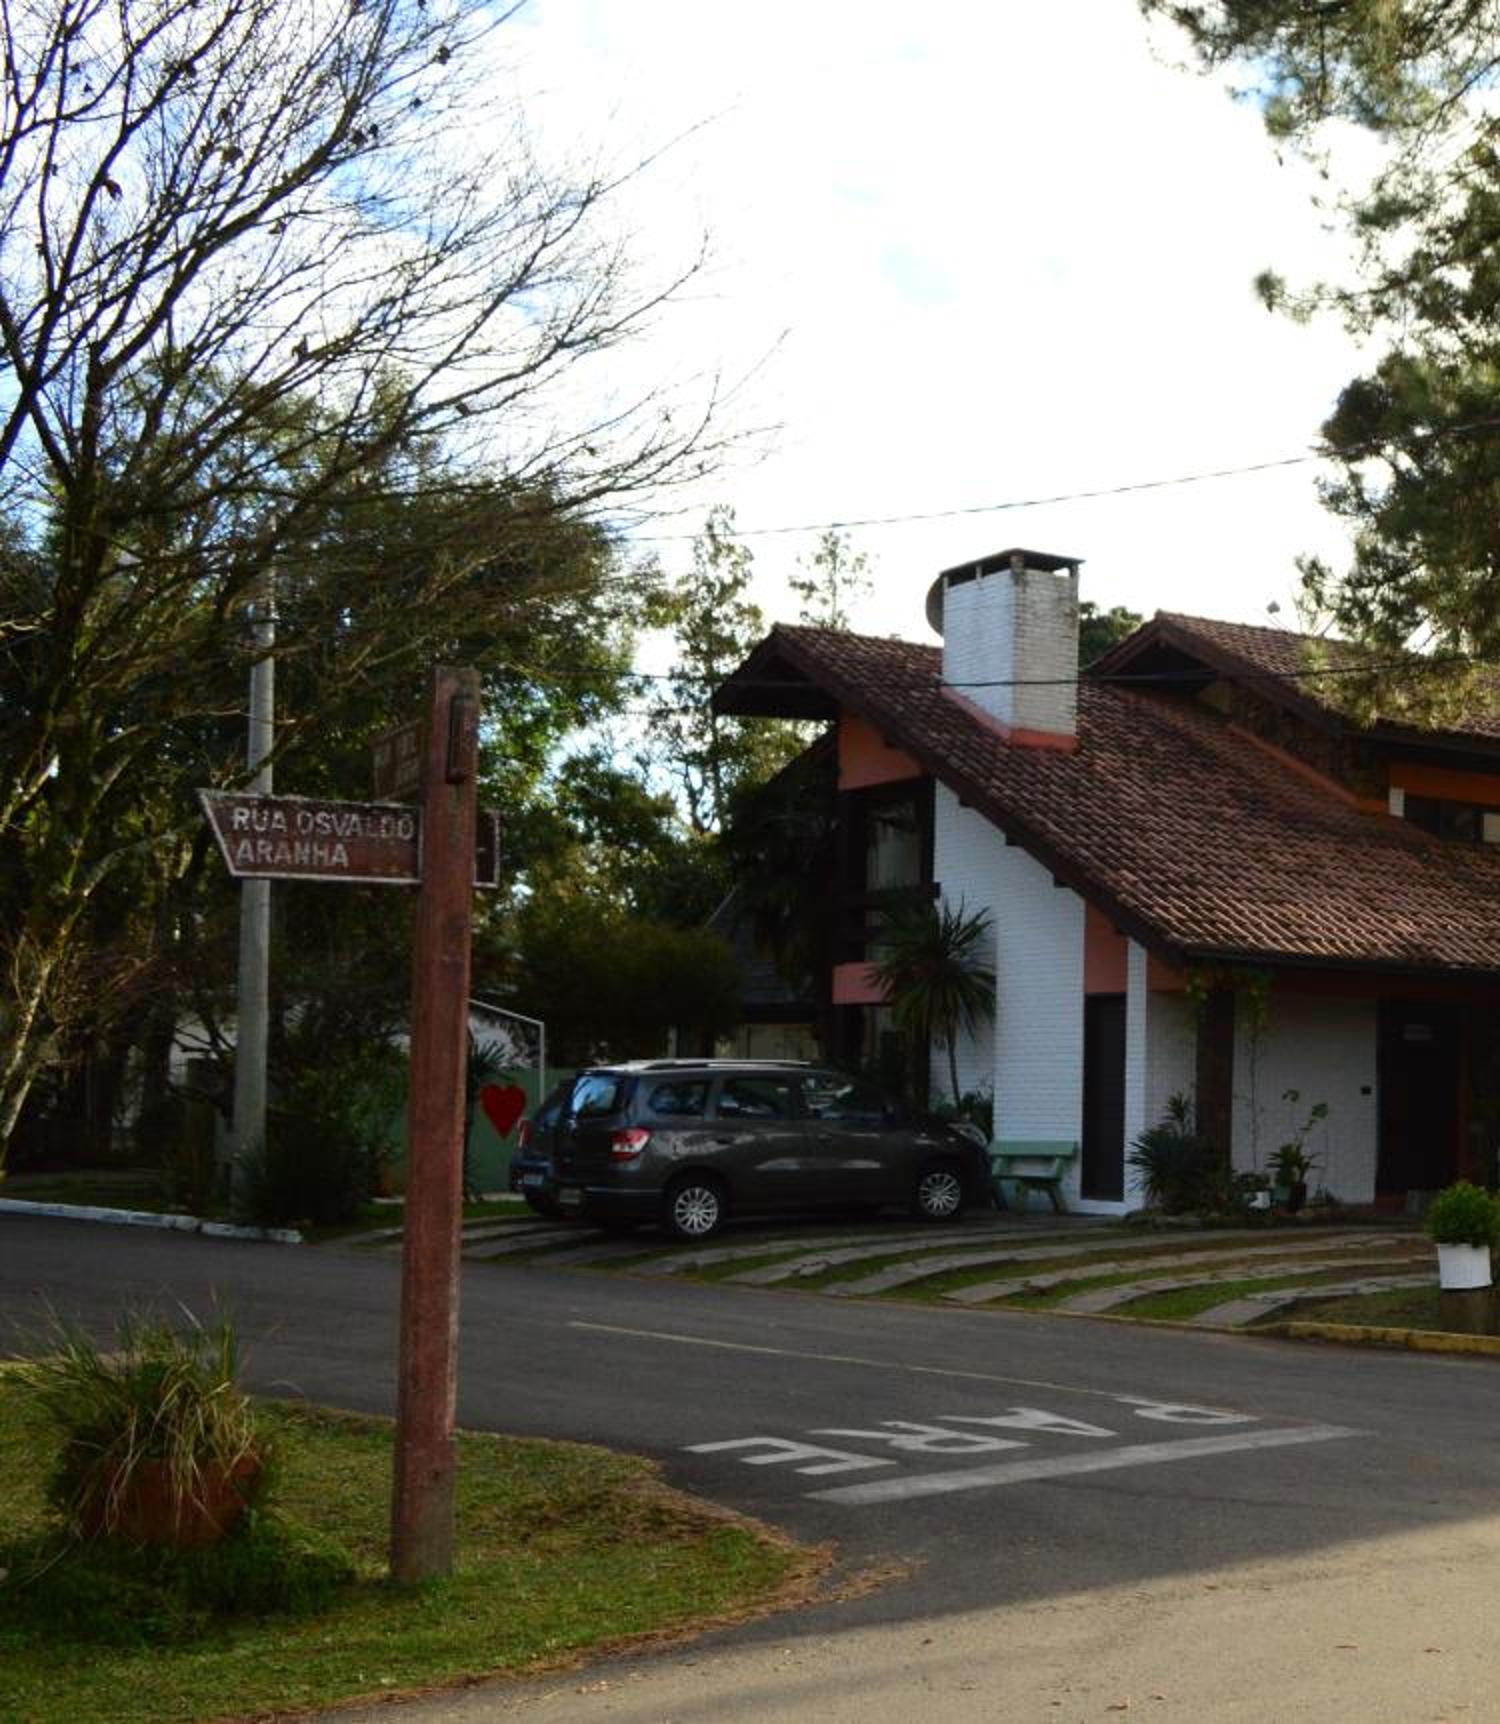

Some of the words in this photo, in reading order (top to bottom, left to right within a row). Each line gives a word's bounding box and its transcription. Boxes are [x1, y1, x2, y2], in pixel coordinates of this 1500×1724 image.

[233, 807, 288, 832] RUA
[296, 811, 415, 841] OSVALDO
[235, 840, 350, 868] ARANHA
[684, 1397, 1262, 1476] PARE
